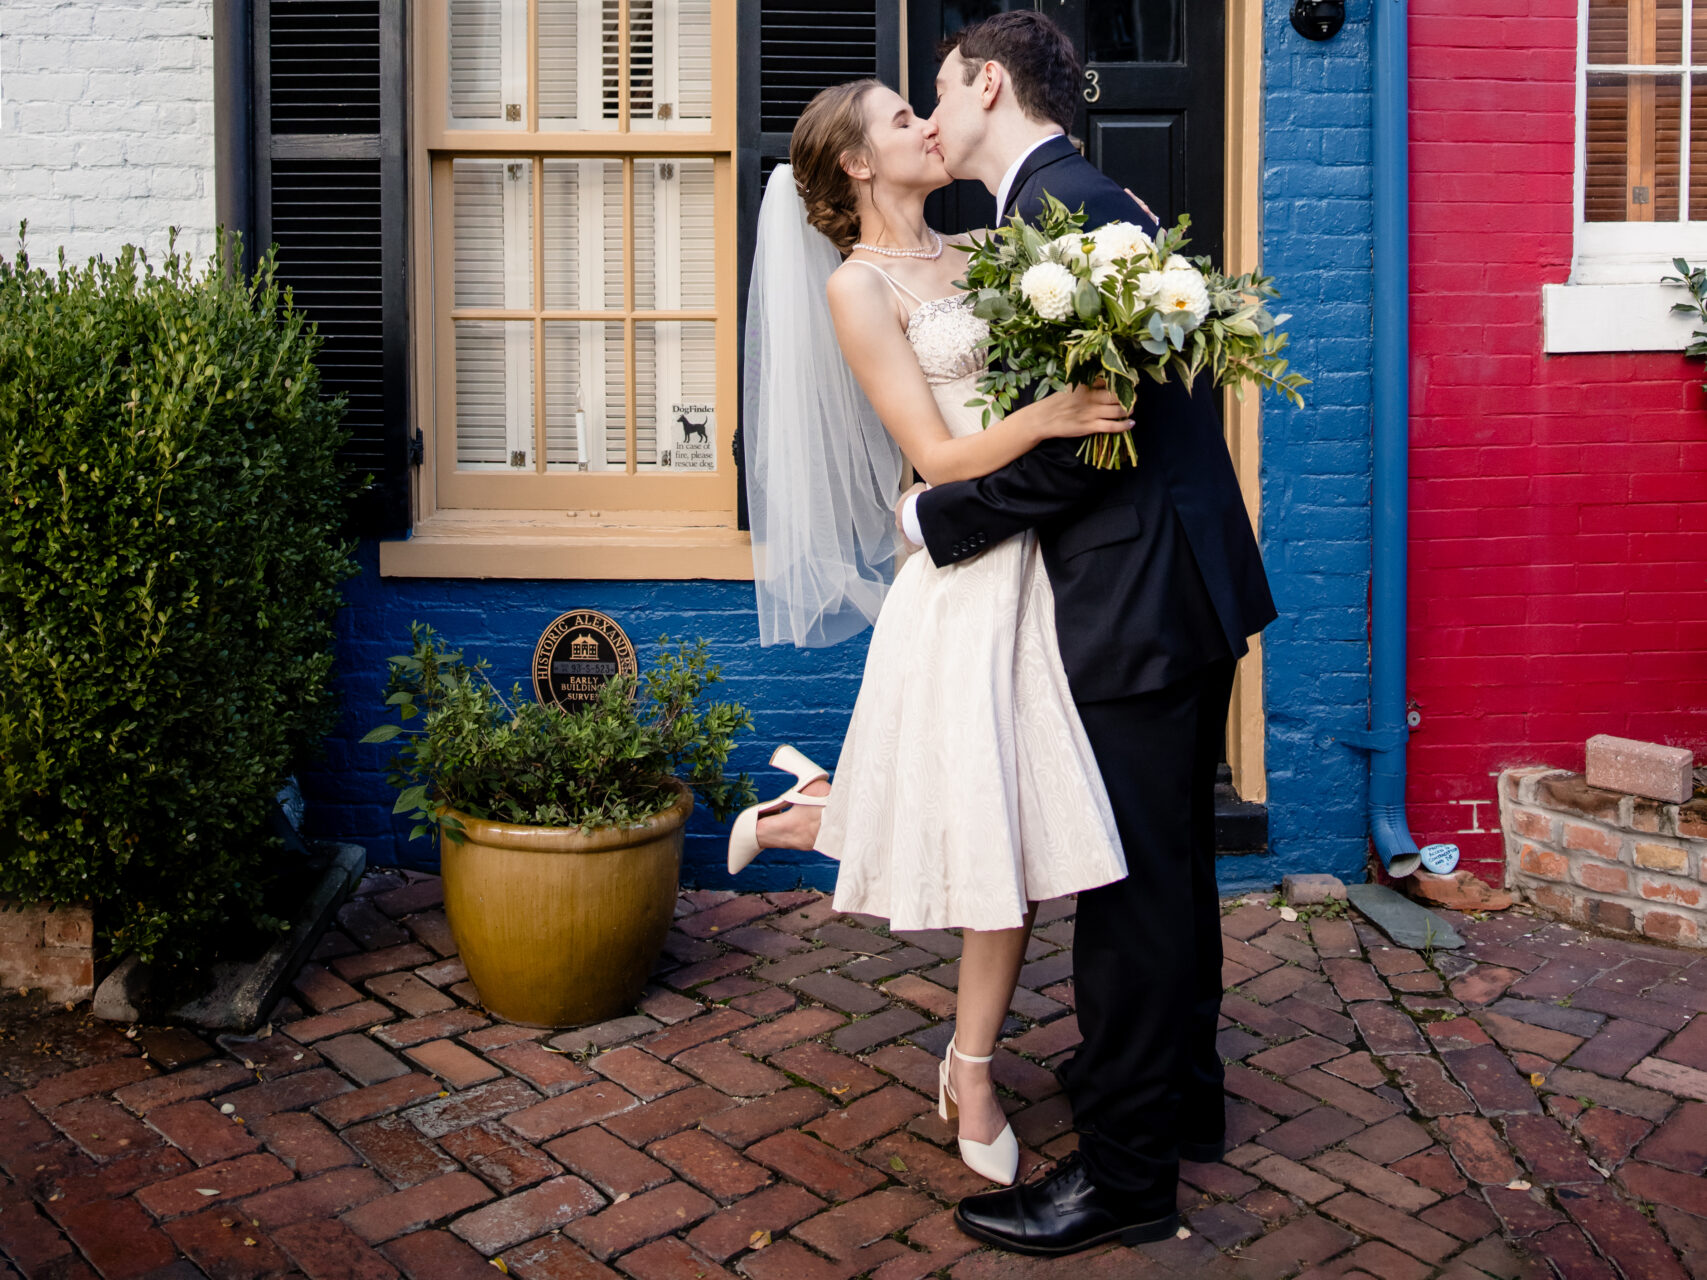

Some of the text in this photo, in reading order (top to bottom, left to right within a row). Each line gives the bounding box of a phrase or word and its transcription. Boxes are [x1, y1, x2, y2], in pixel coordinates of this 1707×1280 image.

[1083, 70, 1100, 103] 3
[672, 405, 714, 414] DogFinder
[676, 442, 684, 450] In
[691, 451, 712, 460] please
[538, 614, 634, 679] HISTORIC ALEXANDR
[569, 676, 599, 685] EARLY
